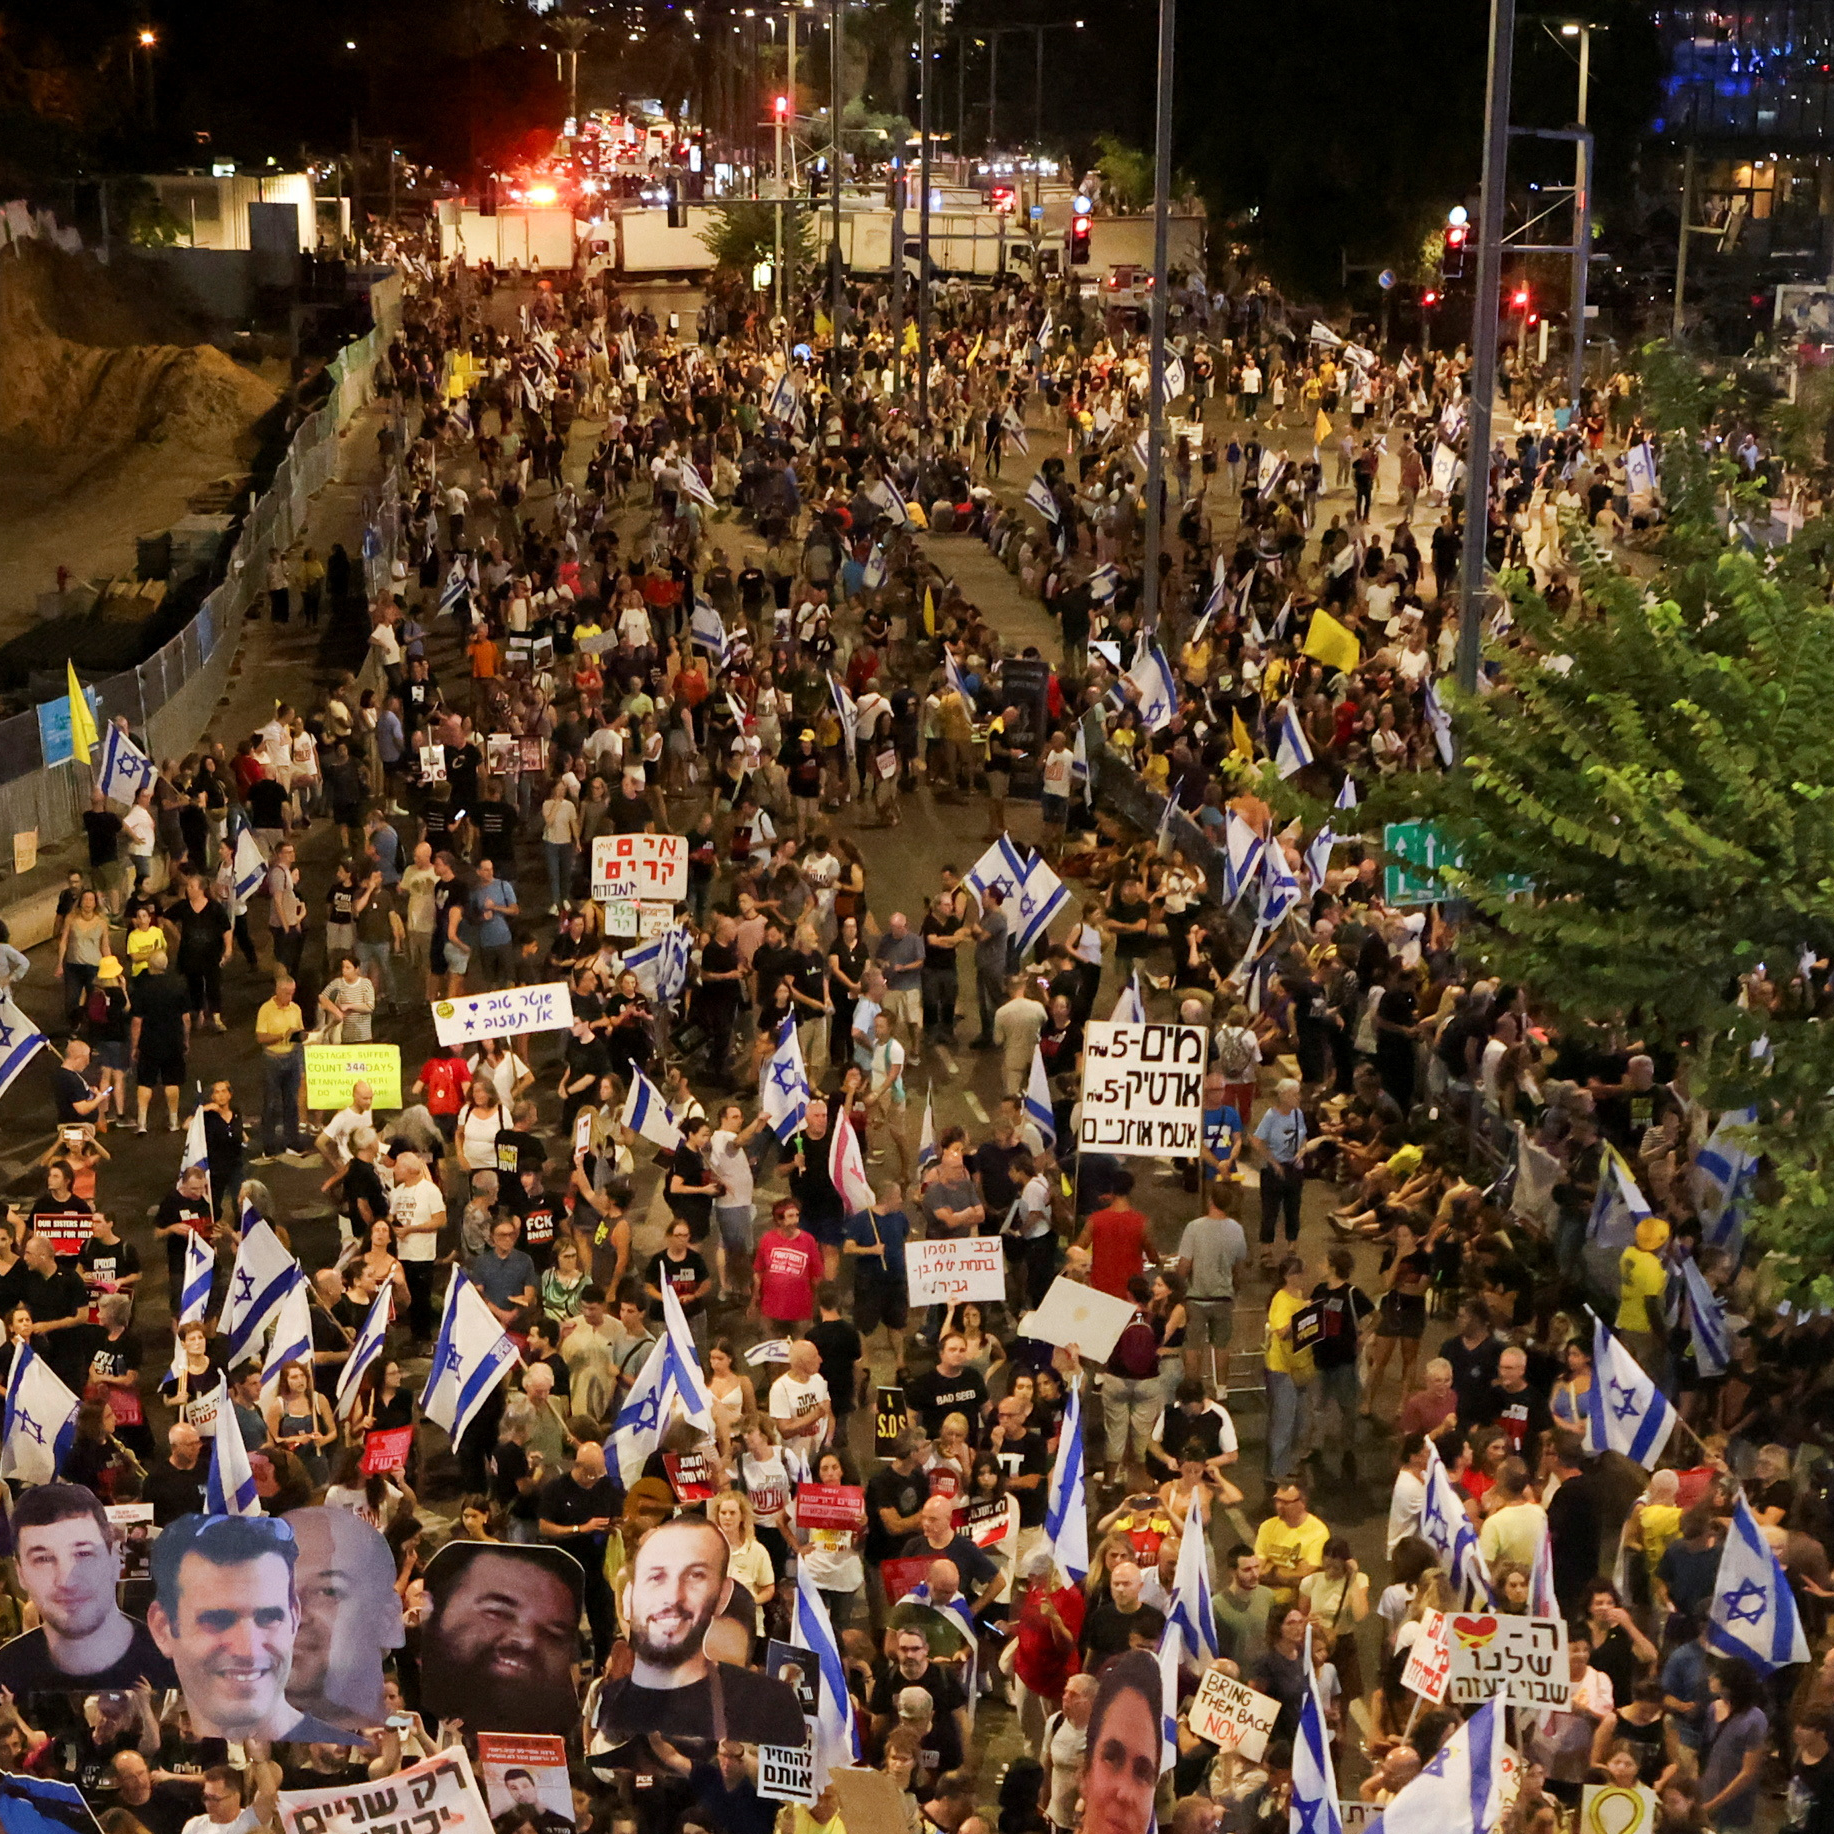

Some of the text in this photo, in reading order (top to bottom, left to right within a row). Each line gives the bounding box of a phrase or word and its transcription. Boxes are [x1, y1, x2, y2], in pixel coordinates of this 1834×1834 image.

[606, 860, 674, 886] קרים
[488, 993, 553, 1011] שוטר טוב
[484, 1009, 553, 1029] אל תעזוב
[308, 1051, 390, 1060] HOSTAGES SUFFER
[308, 1062, 342, 1073] COUNT
[38, 1220, 93, 1228] OUR SISTERS ARE
[526, 1215, 554, 1231] FCK
[36, 1231, 94, 1239] CALLING FOR HELP
[936, 1389, 976, 1406] BAD SEED
[1471, 1648, 1551, 1677] שלנו
[1206, 1674, 1252, 1707] BRING
[1528, 1681, 1569, 1704] שבוי
[1202, 1691, 1273, 1738] THEM BACK
[1204, 1713, 1247, 1747] NOW
[763, 1748, 813, 1768] להחזיר
[408, 1762, 467, 1809] רק
[764, 1766, 813, 1789] אותם
